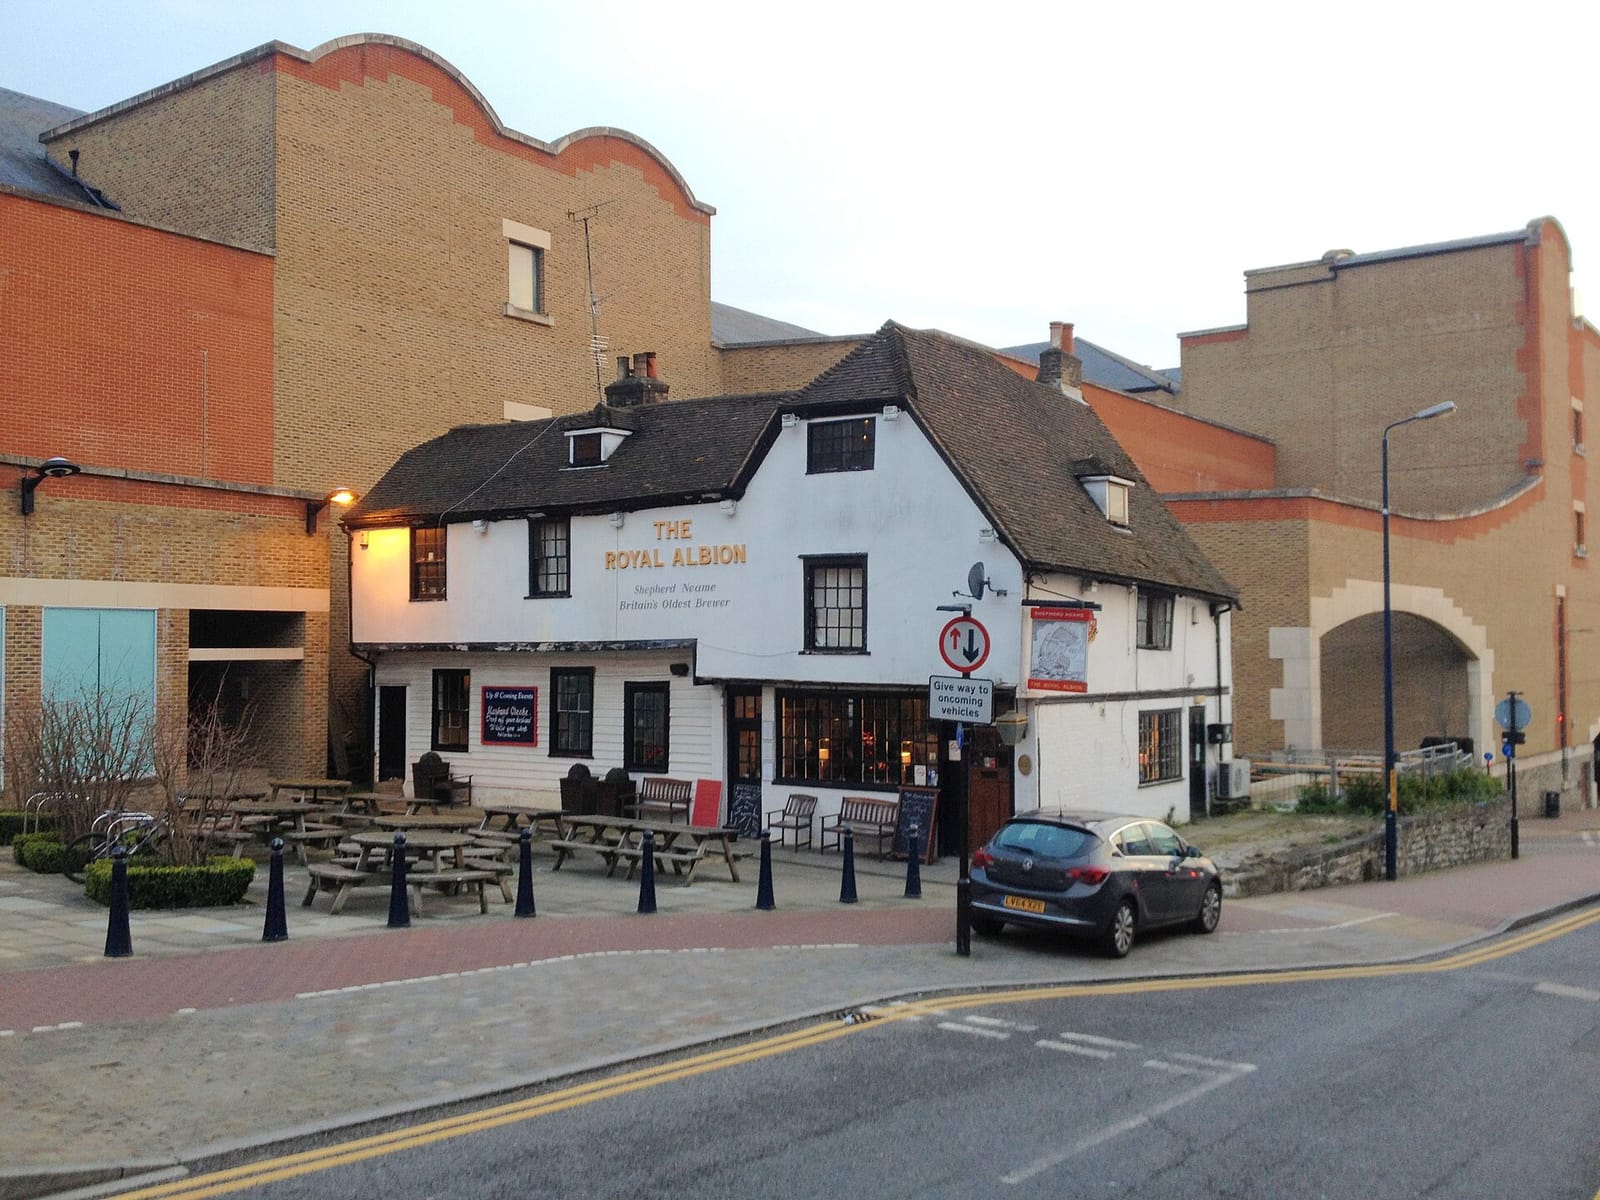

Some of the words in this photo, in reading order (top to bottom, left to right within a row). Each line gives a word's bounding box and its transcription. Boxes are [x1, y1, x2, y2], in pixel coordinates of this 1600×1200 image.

[654, 519, 692, 540] THE
[605, 549, 665, 570] ROYAL
[672, 544, 747, 566] ALBION
[634, 584, 676, 596] Shepherd
[681, 583, 716, 593] Neame
[619, 599, 658, 611] Britain's
[662, 598, 691, 609] Oldest
[695, 598, 731, 608] Brewer
[934, 681, 954, 691] Give
[957, 684, 976, 695] way
[979, 685, 989, 694] to
[486, 691, 494, 700] Up
[500, 691, 518, 701] Coming
[518, 691, 534, 700] Events
[938, 695, 983, 707] oncoming
[941, 706, 980, 717] vehicles
